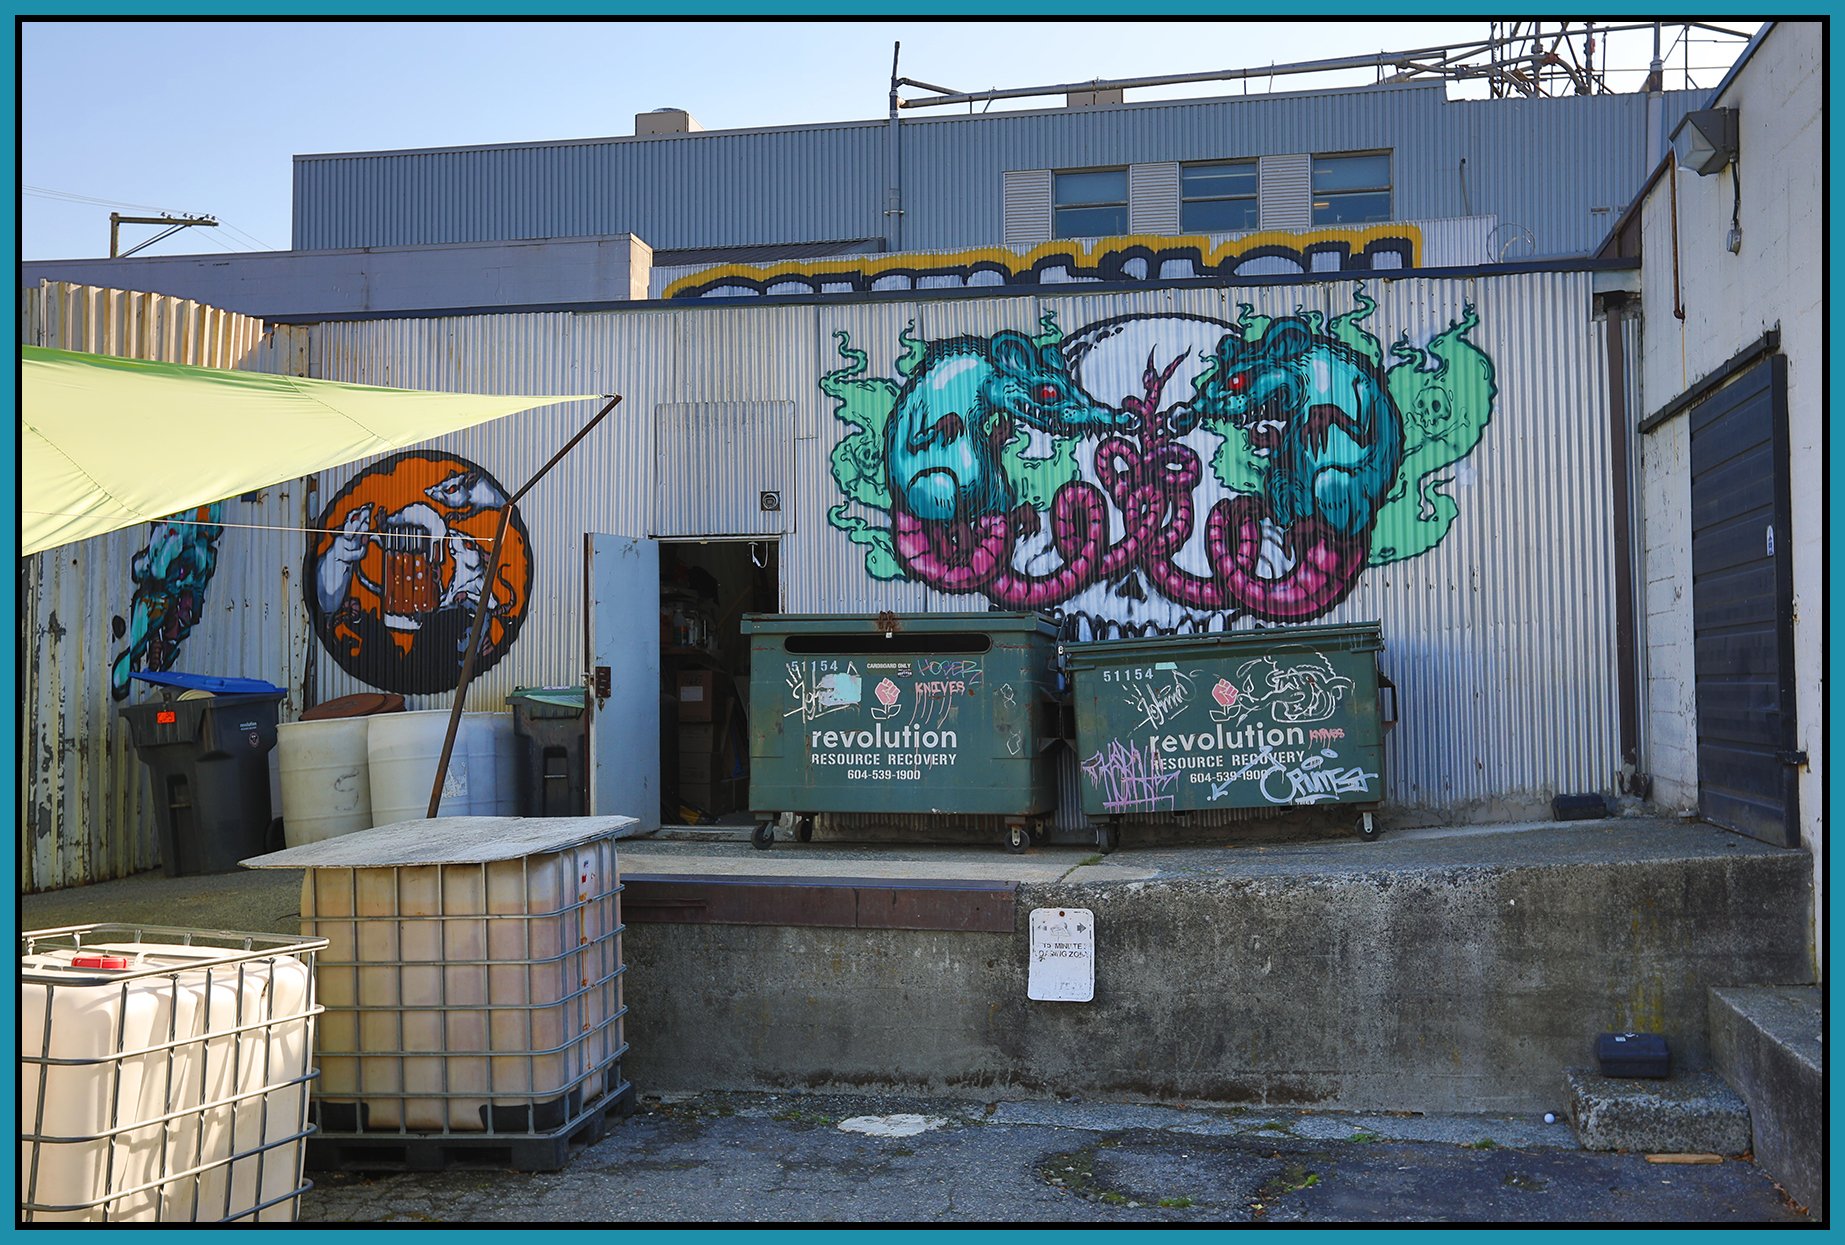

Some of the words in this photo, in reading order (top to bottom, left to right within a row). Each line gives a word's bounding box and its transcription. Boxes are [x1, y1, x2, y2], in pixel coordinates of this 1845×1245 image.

[791, 660, 838, 672] 51154
[1103, 668, 1153, 682] 51154
[811, 722, 957, 748] revolution
[1150, 721, 1304, 753] revolution
[811, 753, 880, 765] RESOURCE
[888, 753, 957, 765] RECOVERY
[1232, 750, 1304, 767] RECOVERY
[847, 769, 921, 780] 604-539-1900
